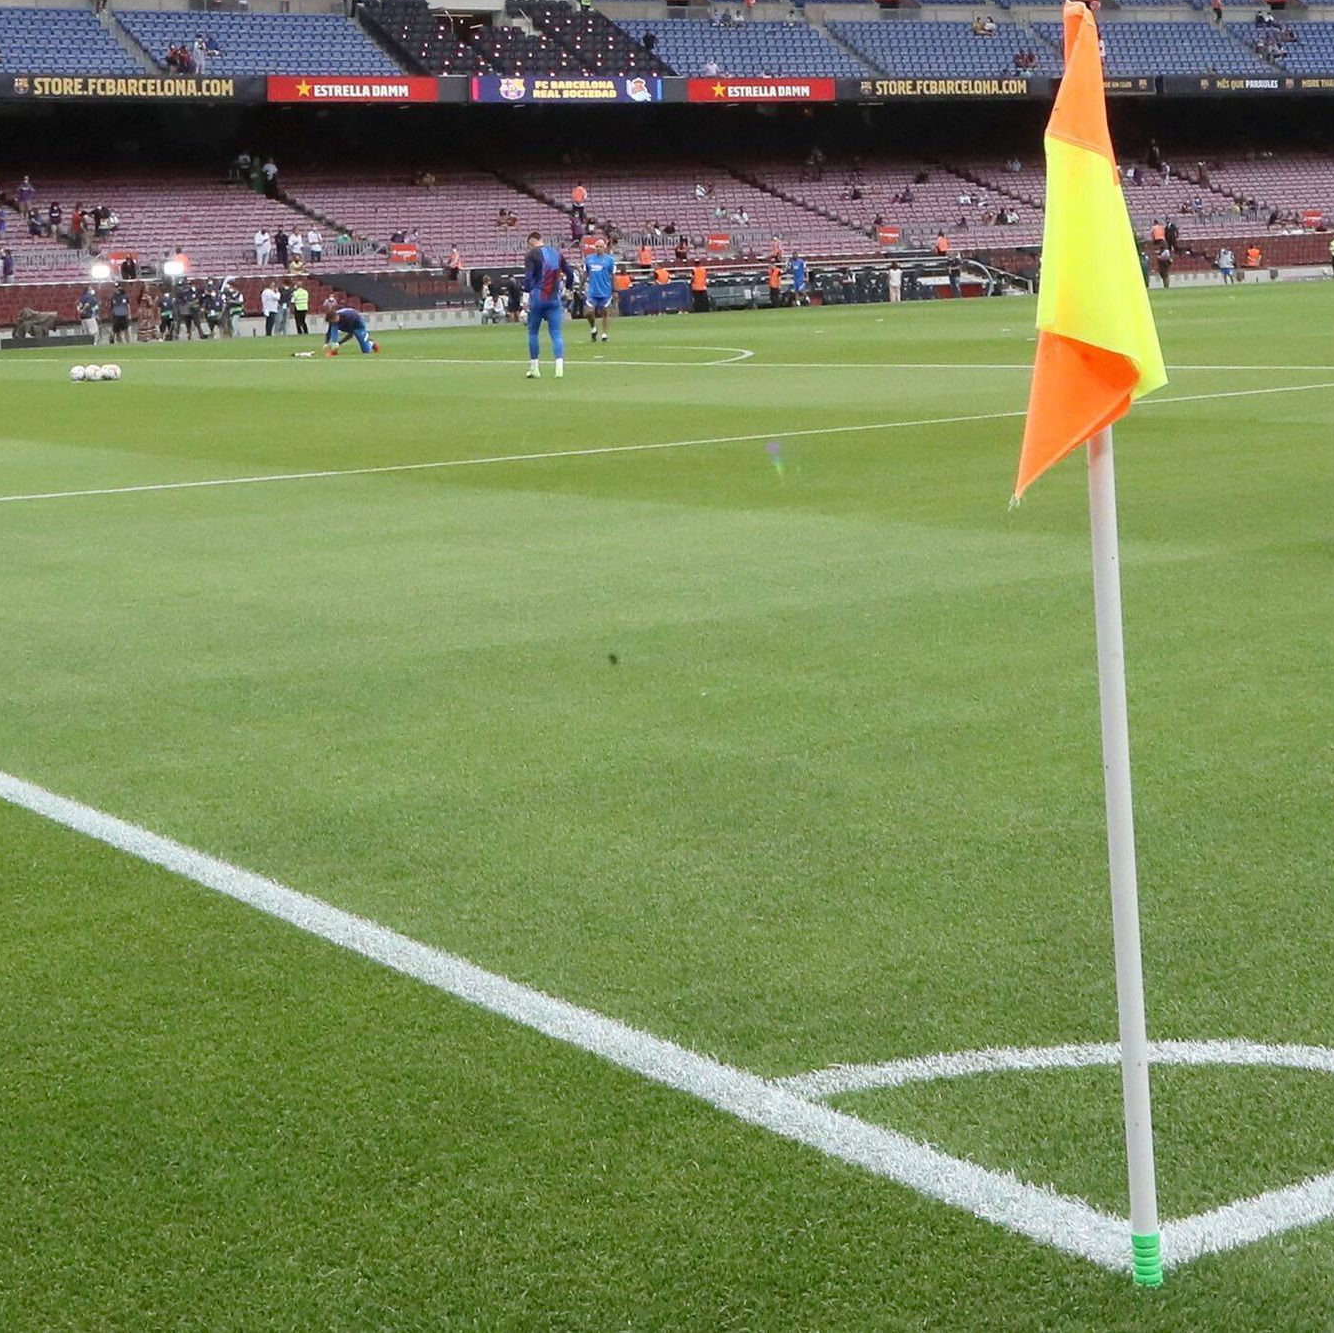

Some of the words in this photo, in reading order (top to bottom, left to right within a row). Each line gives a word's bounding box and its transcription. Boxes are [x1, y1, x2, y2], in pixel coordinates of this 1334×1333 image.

[33, 77, 234, 96] STORE.FCBARCELONA.COM
[314, 84, 371, 97] ESTRELLA
[372, 84, 409, 97] DAMM
[534, 80, 549, 89] FC
[550, 80, 614, 89] BARCELONA
[875, 79, 1027, 95] STORE.FCBARCELONA.COM
[533, 89, 561, 98] REAL
[562, 89, 617, 98] SOCIEDAD
[727, 85, 777, 97] ESTRELLA
[778, 85, 810, 97] DAMM
